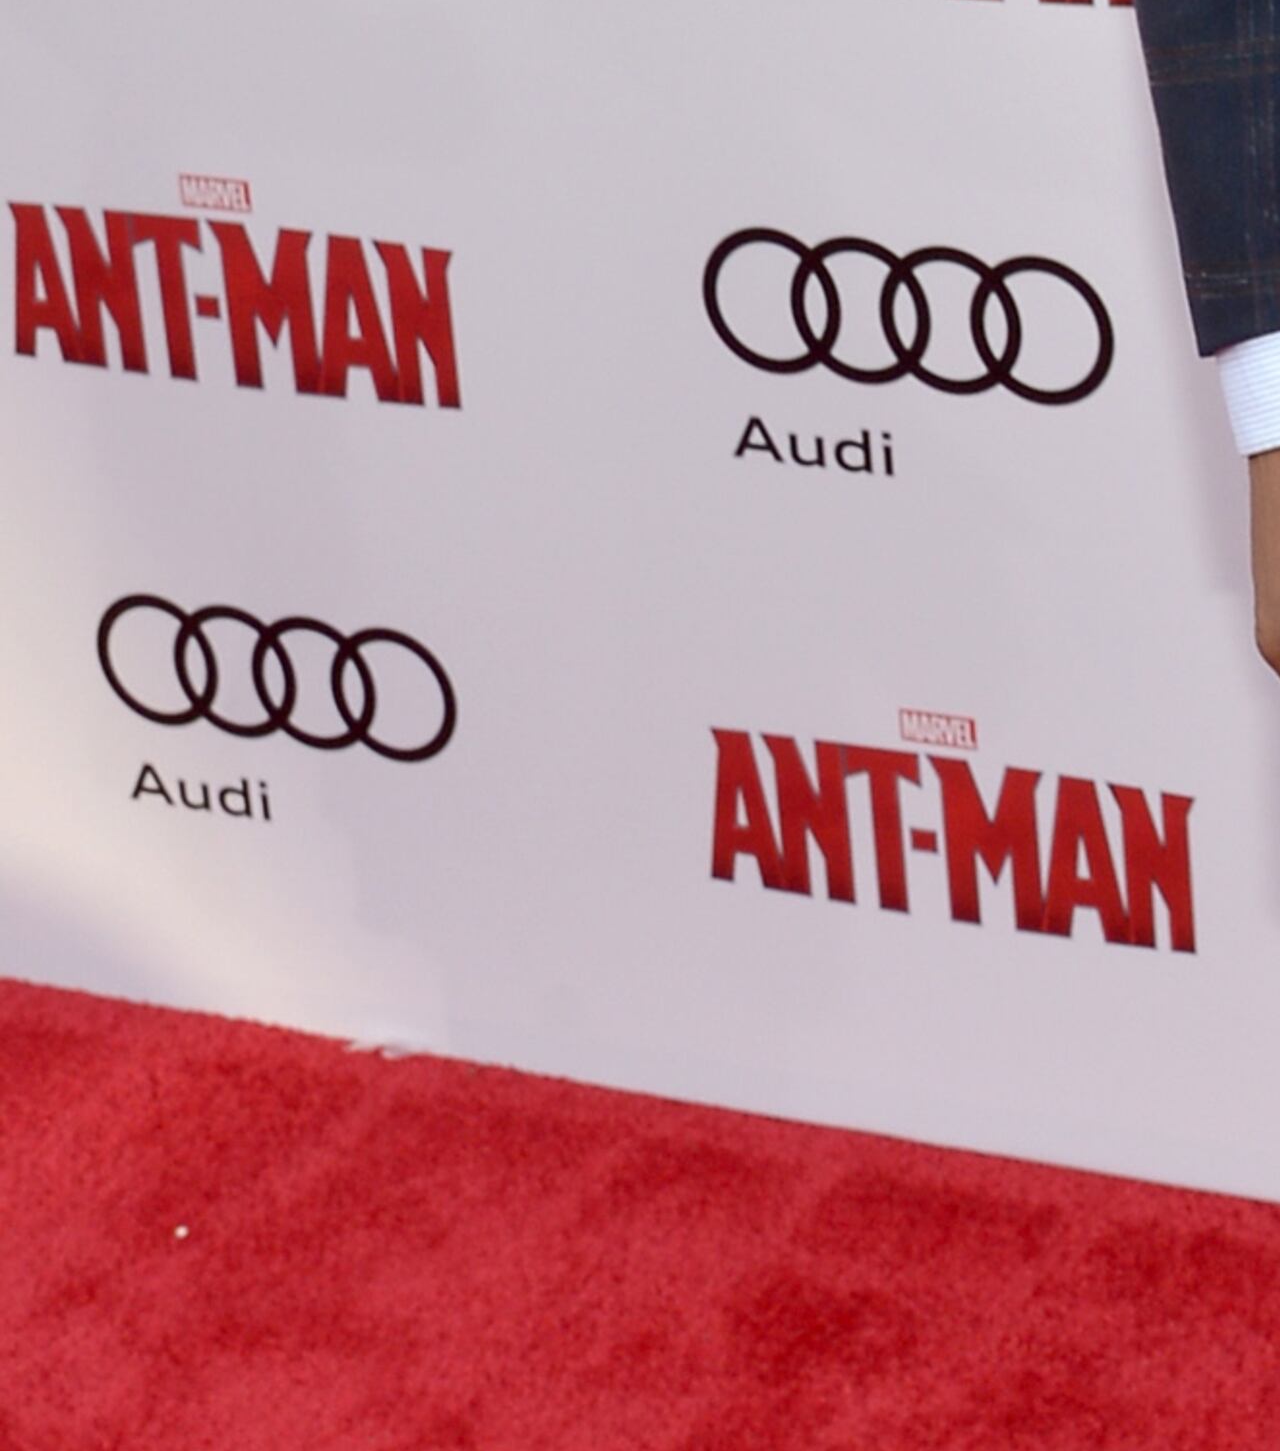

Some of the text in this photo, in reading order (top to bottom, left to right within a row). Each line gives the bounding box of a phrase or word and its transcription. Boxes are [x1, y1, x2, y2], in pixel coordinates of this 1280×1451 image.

[9, 201, 462, 410] ANT-MAN
[734, 416, 895, 477] Audi
[899, 707, 978, 751] MARVEL
[131, 763, 271, 821] Audi
[709, 726, 1197, 955] ANT-MAN
